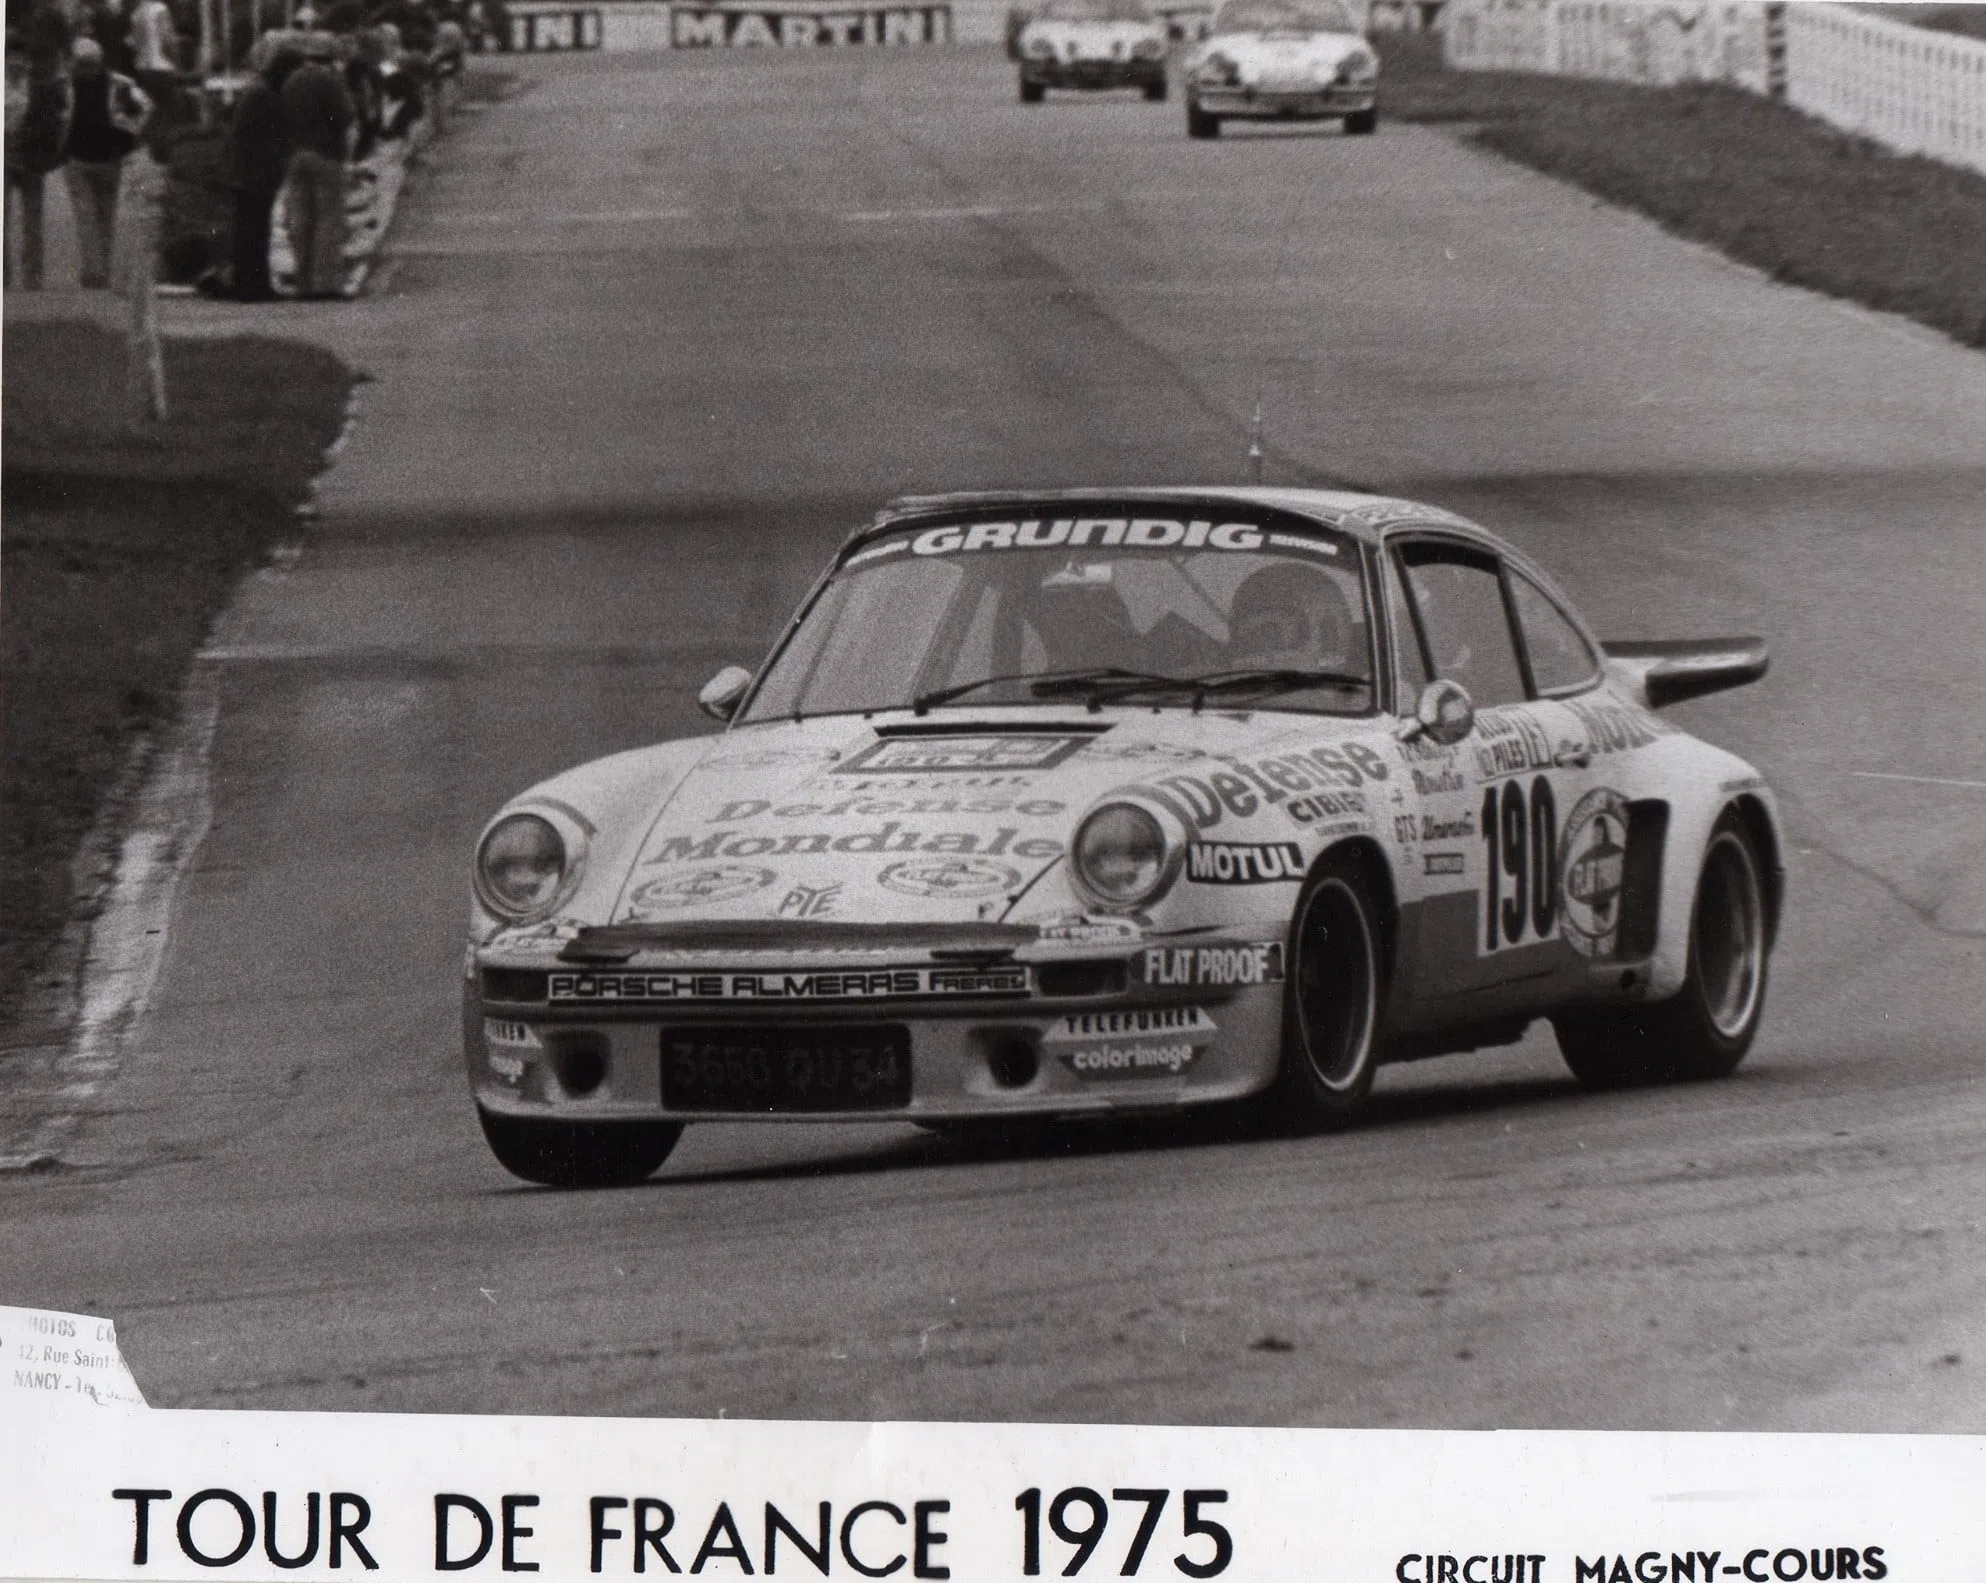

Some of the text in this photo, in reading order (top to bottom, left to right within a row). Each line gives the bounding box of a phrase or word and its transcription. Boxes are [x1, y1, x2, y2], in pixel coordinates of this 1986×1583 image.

[674, 8, 948, 48] MARTINI
[912, 519, 1264, 555] GRUNDIG
[1153, 742, 1389, 830] Defense
[703, 797, 1067, 823] Defense
[642, 822, 1065, 865] Mondiale
[1190, 844, 1303, 879] MOTUL
[1482, 774, 1557, 950] 190
[778, 882, 843, 916] PYE
[1144, 945, 1268, 984] FLAT PROOF
[551, 974, 722, 997] PORSCHE
[733, 971, 919, 996] ALMERAS
[1066, 1008, 1198, 1034] TELEFUNKEN
[1073, 1043, 1192, 1071] colorimage
